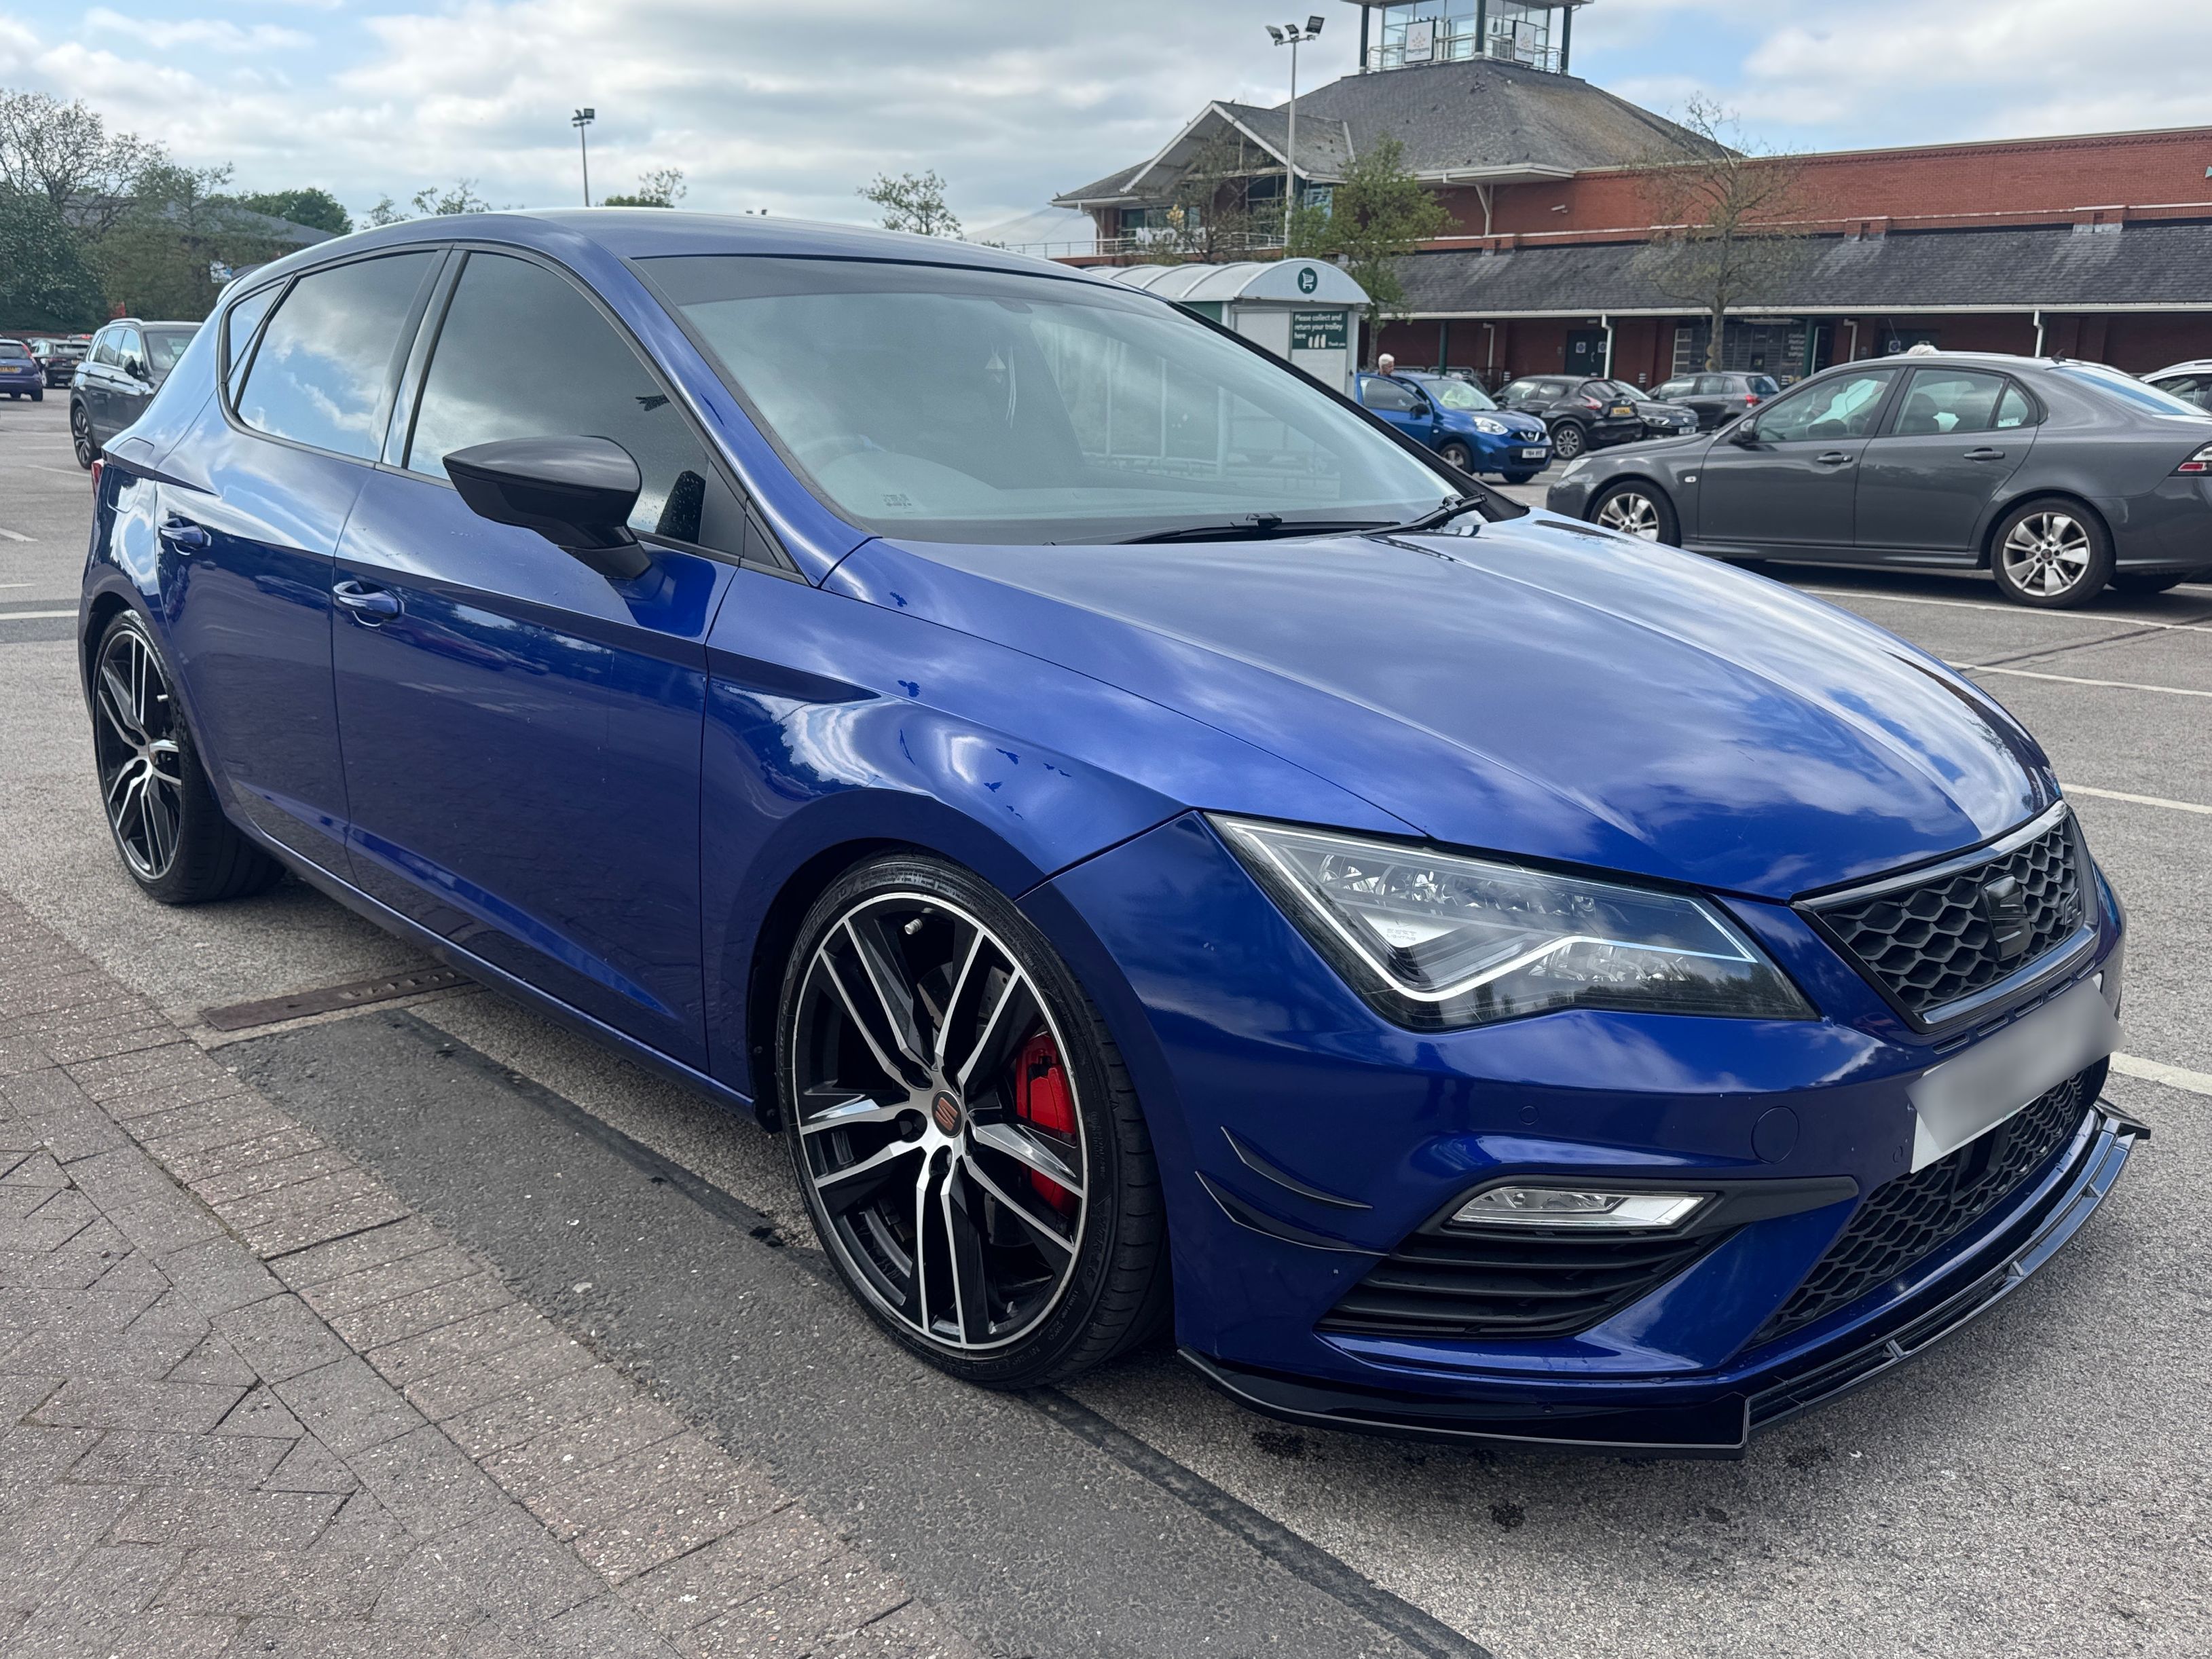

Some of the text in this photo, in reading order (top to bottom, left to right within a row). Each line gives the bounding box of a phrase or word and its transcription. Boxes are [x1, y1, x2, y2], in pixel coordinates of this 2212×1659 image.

[1331, 313, 1342, 321] and
[1325, 322, 1343, 332] trolley
[1294, 331, 1306, 339] here
